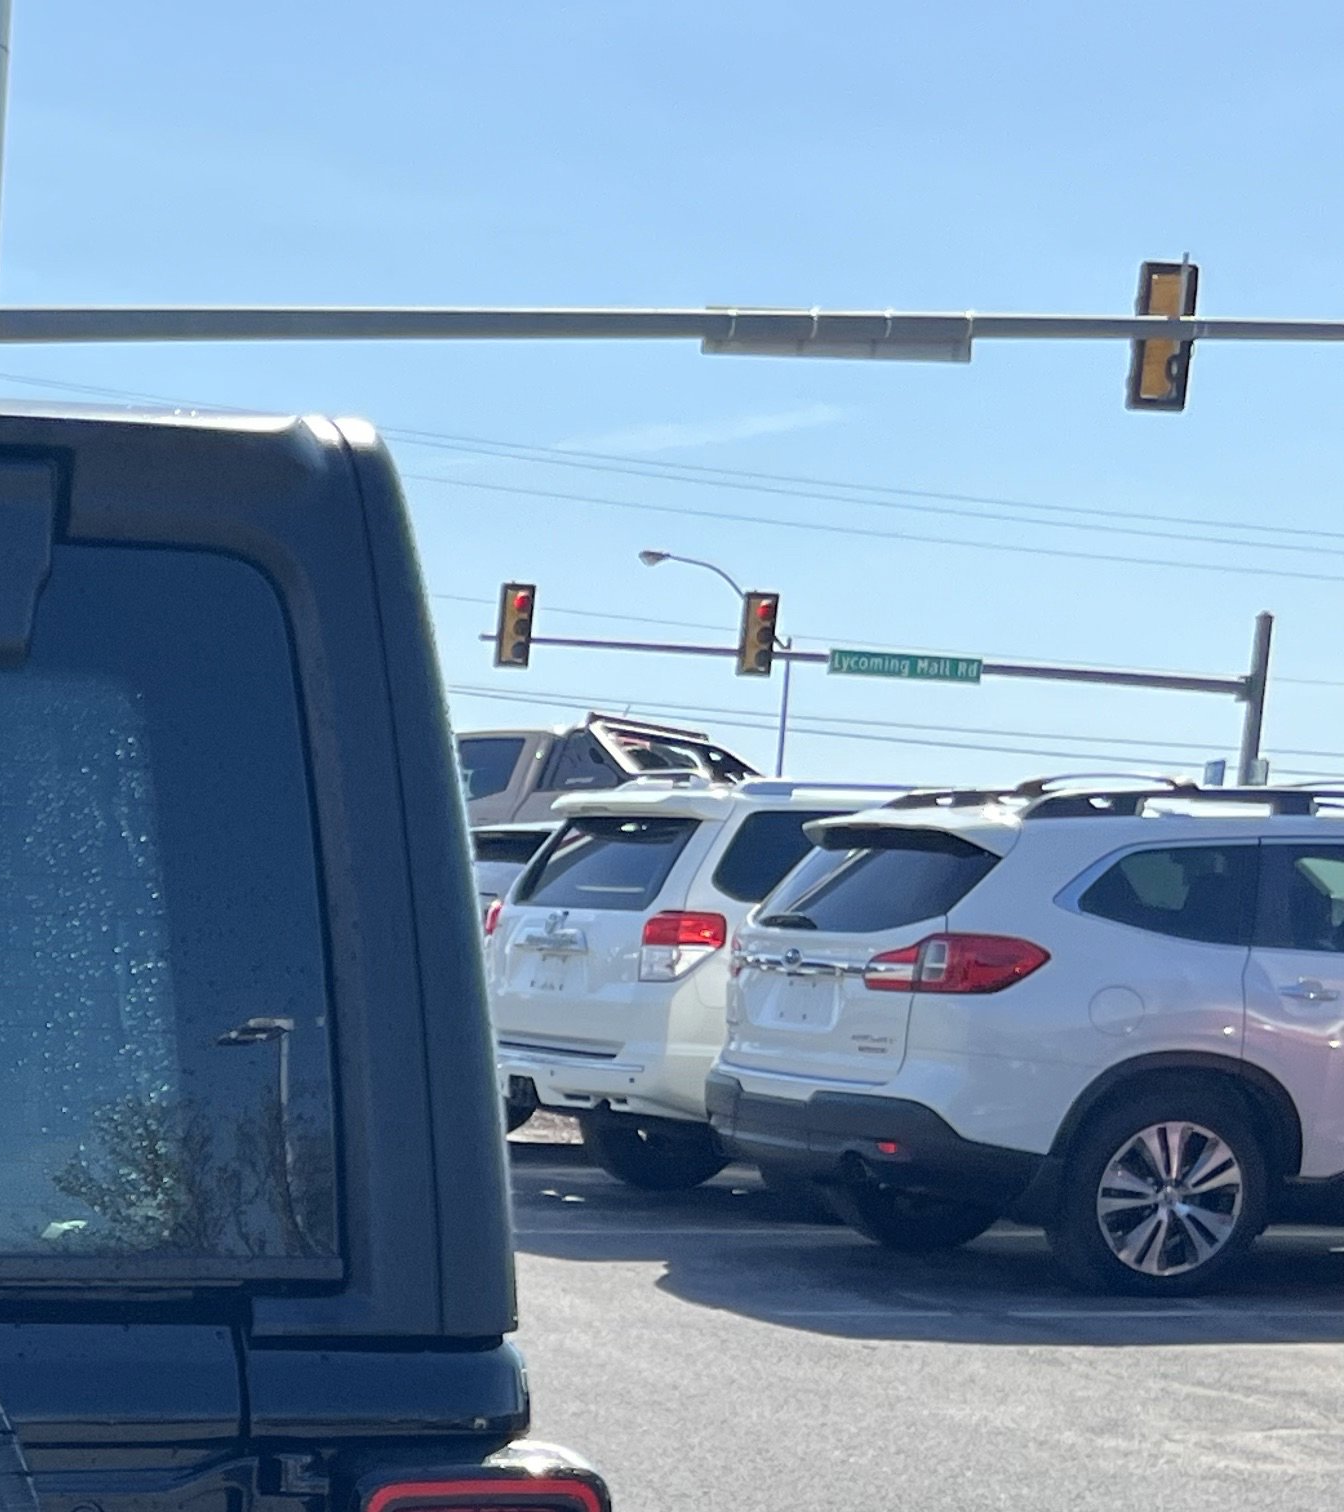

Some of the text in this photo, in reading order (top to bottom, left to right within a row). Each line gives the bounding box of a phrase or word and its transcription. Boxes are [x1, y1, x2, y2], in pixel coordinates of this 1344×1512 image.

[833, 651, 978, 678] Lycoming Mall Rd
